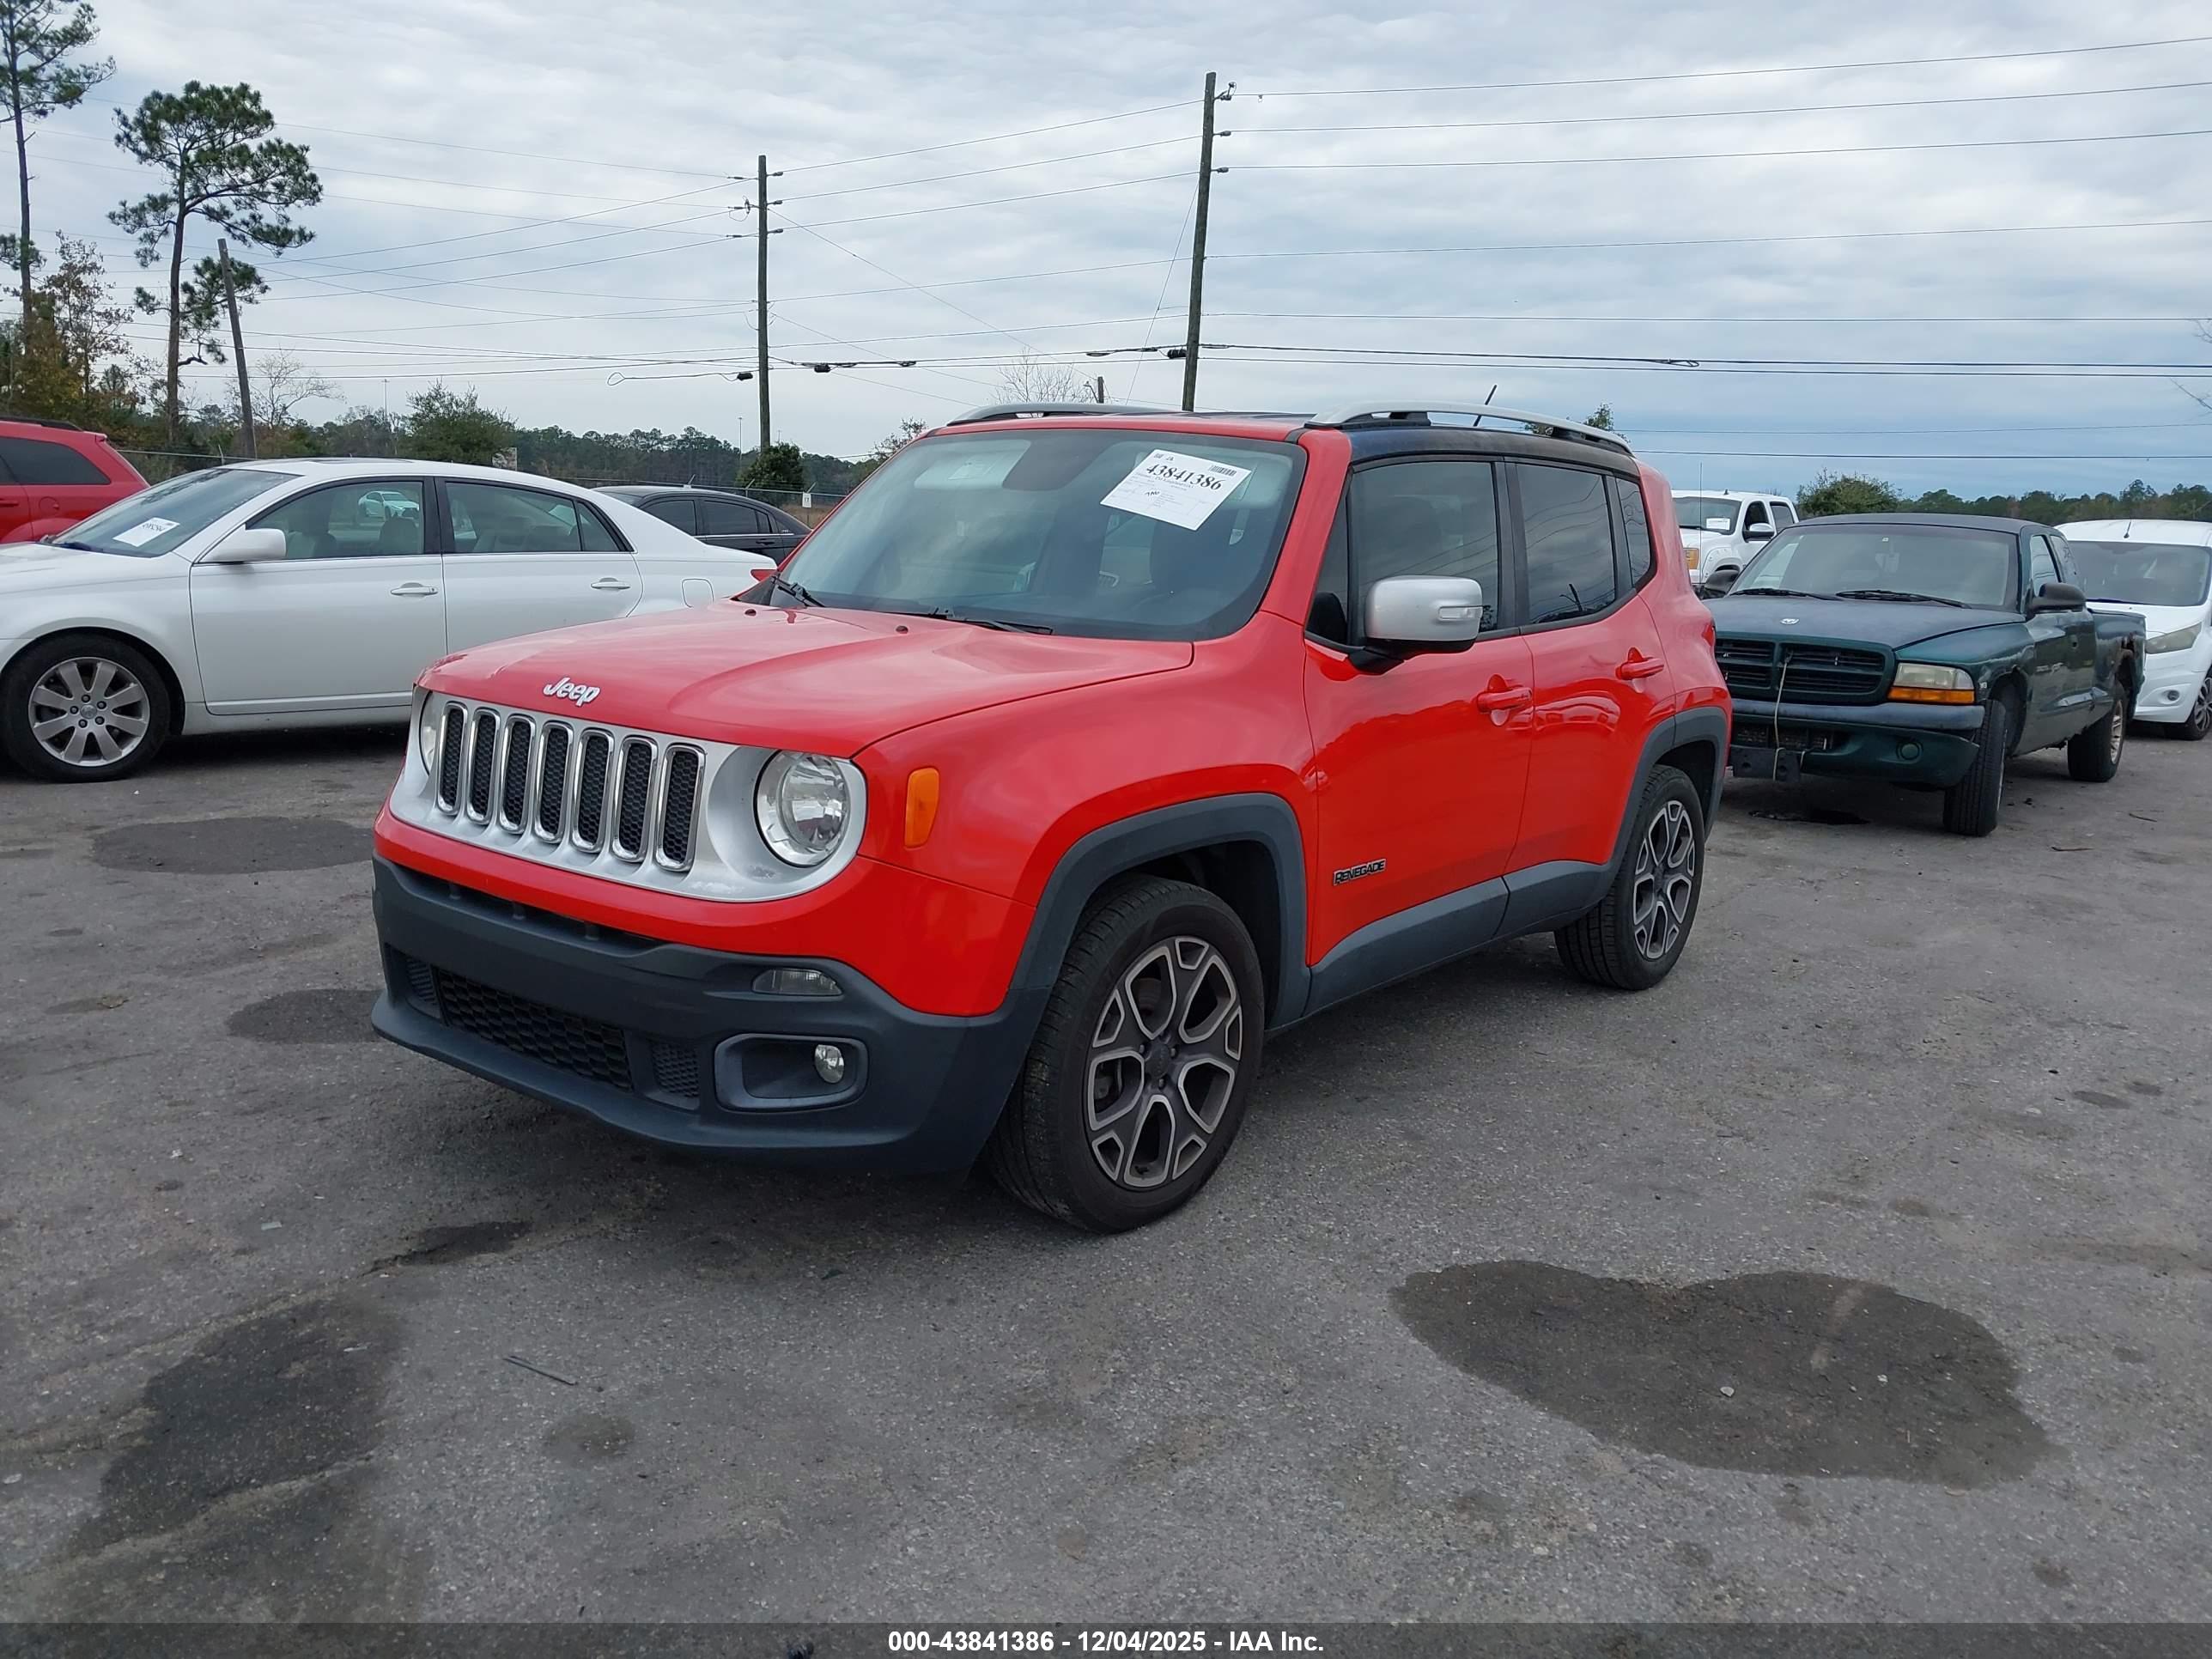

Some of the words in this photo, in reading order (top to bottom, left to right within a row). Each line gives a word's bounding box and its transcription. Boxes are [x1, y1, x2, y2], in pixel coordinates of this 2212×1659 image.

[1146, 464, 1225, 490] 43841386
[543, 677, 600, 707] Jeep
[1333, 859, 1387, 885] RENEGADE
